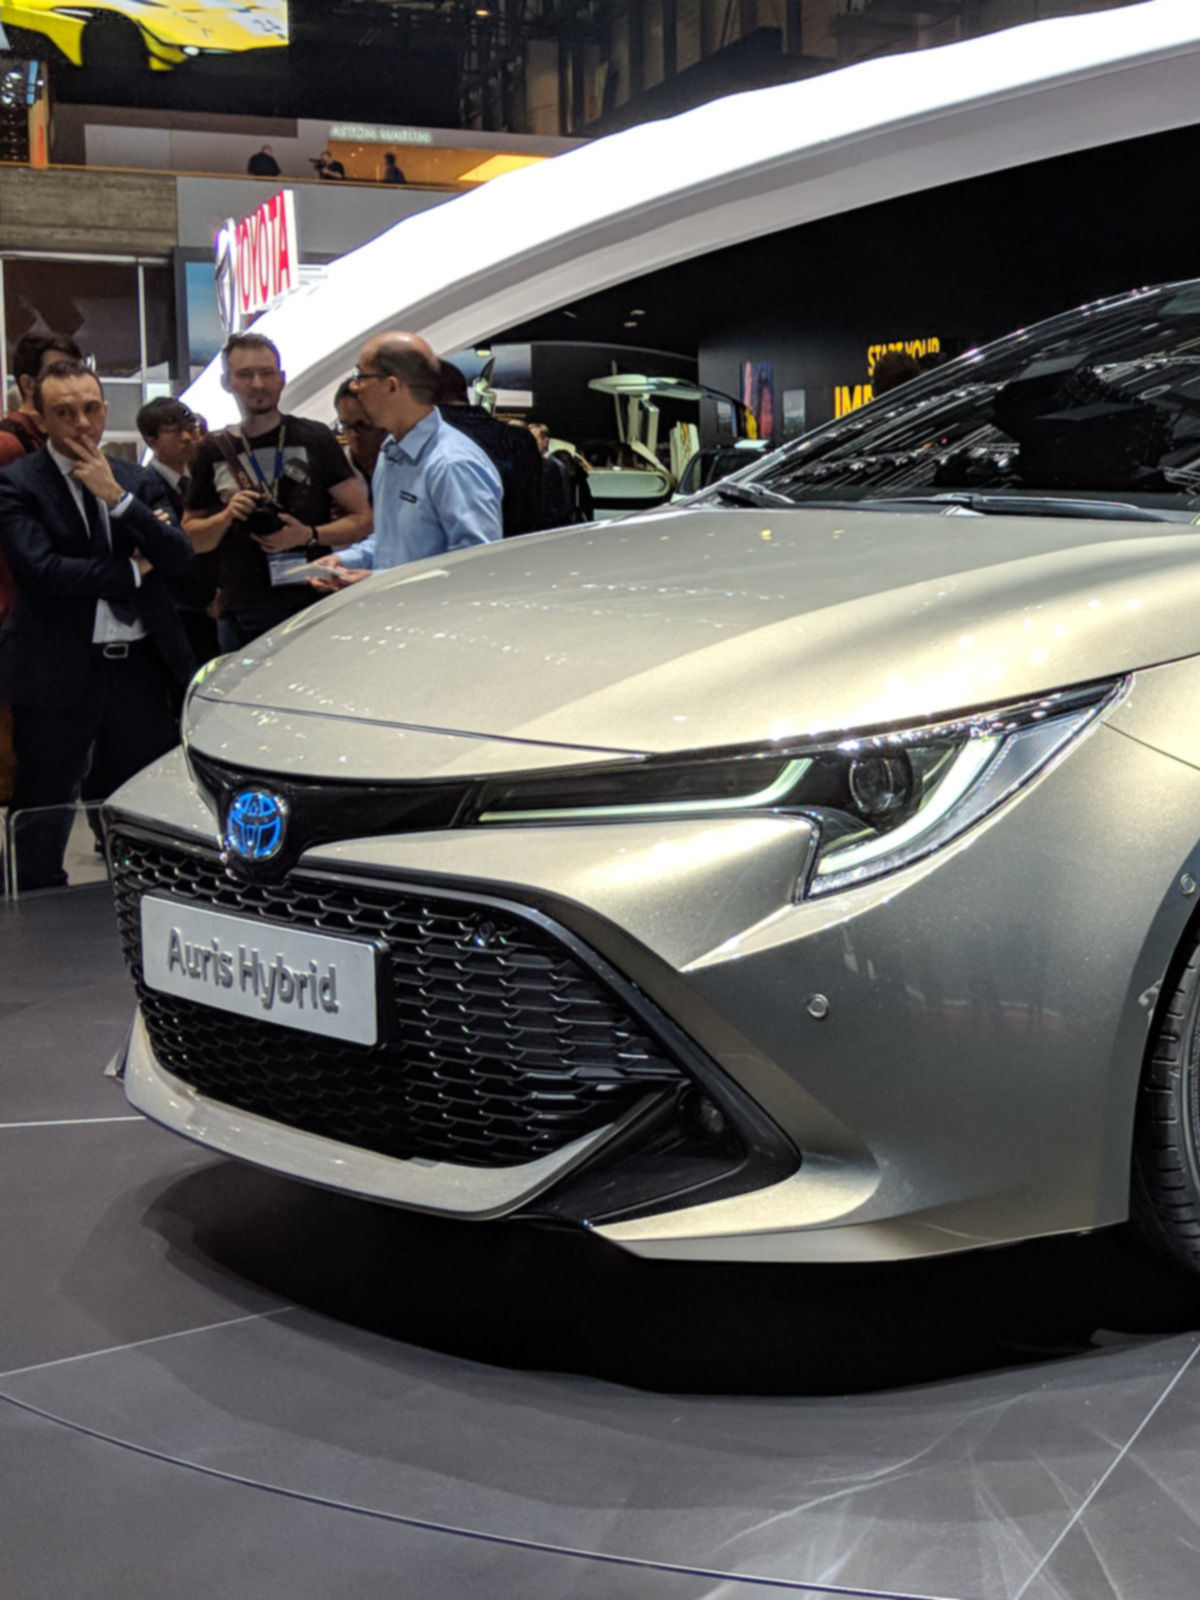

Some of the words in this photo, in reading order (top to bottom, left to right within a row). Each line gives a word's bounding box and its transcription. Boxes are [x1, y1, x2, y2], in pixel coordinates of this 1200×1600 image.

[234, 189, 291, 315] TOYOTA
[167, 926, 234, 990] Auris
[238, 944, 340, 1014] Hybrid
